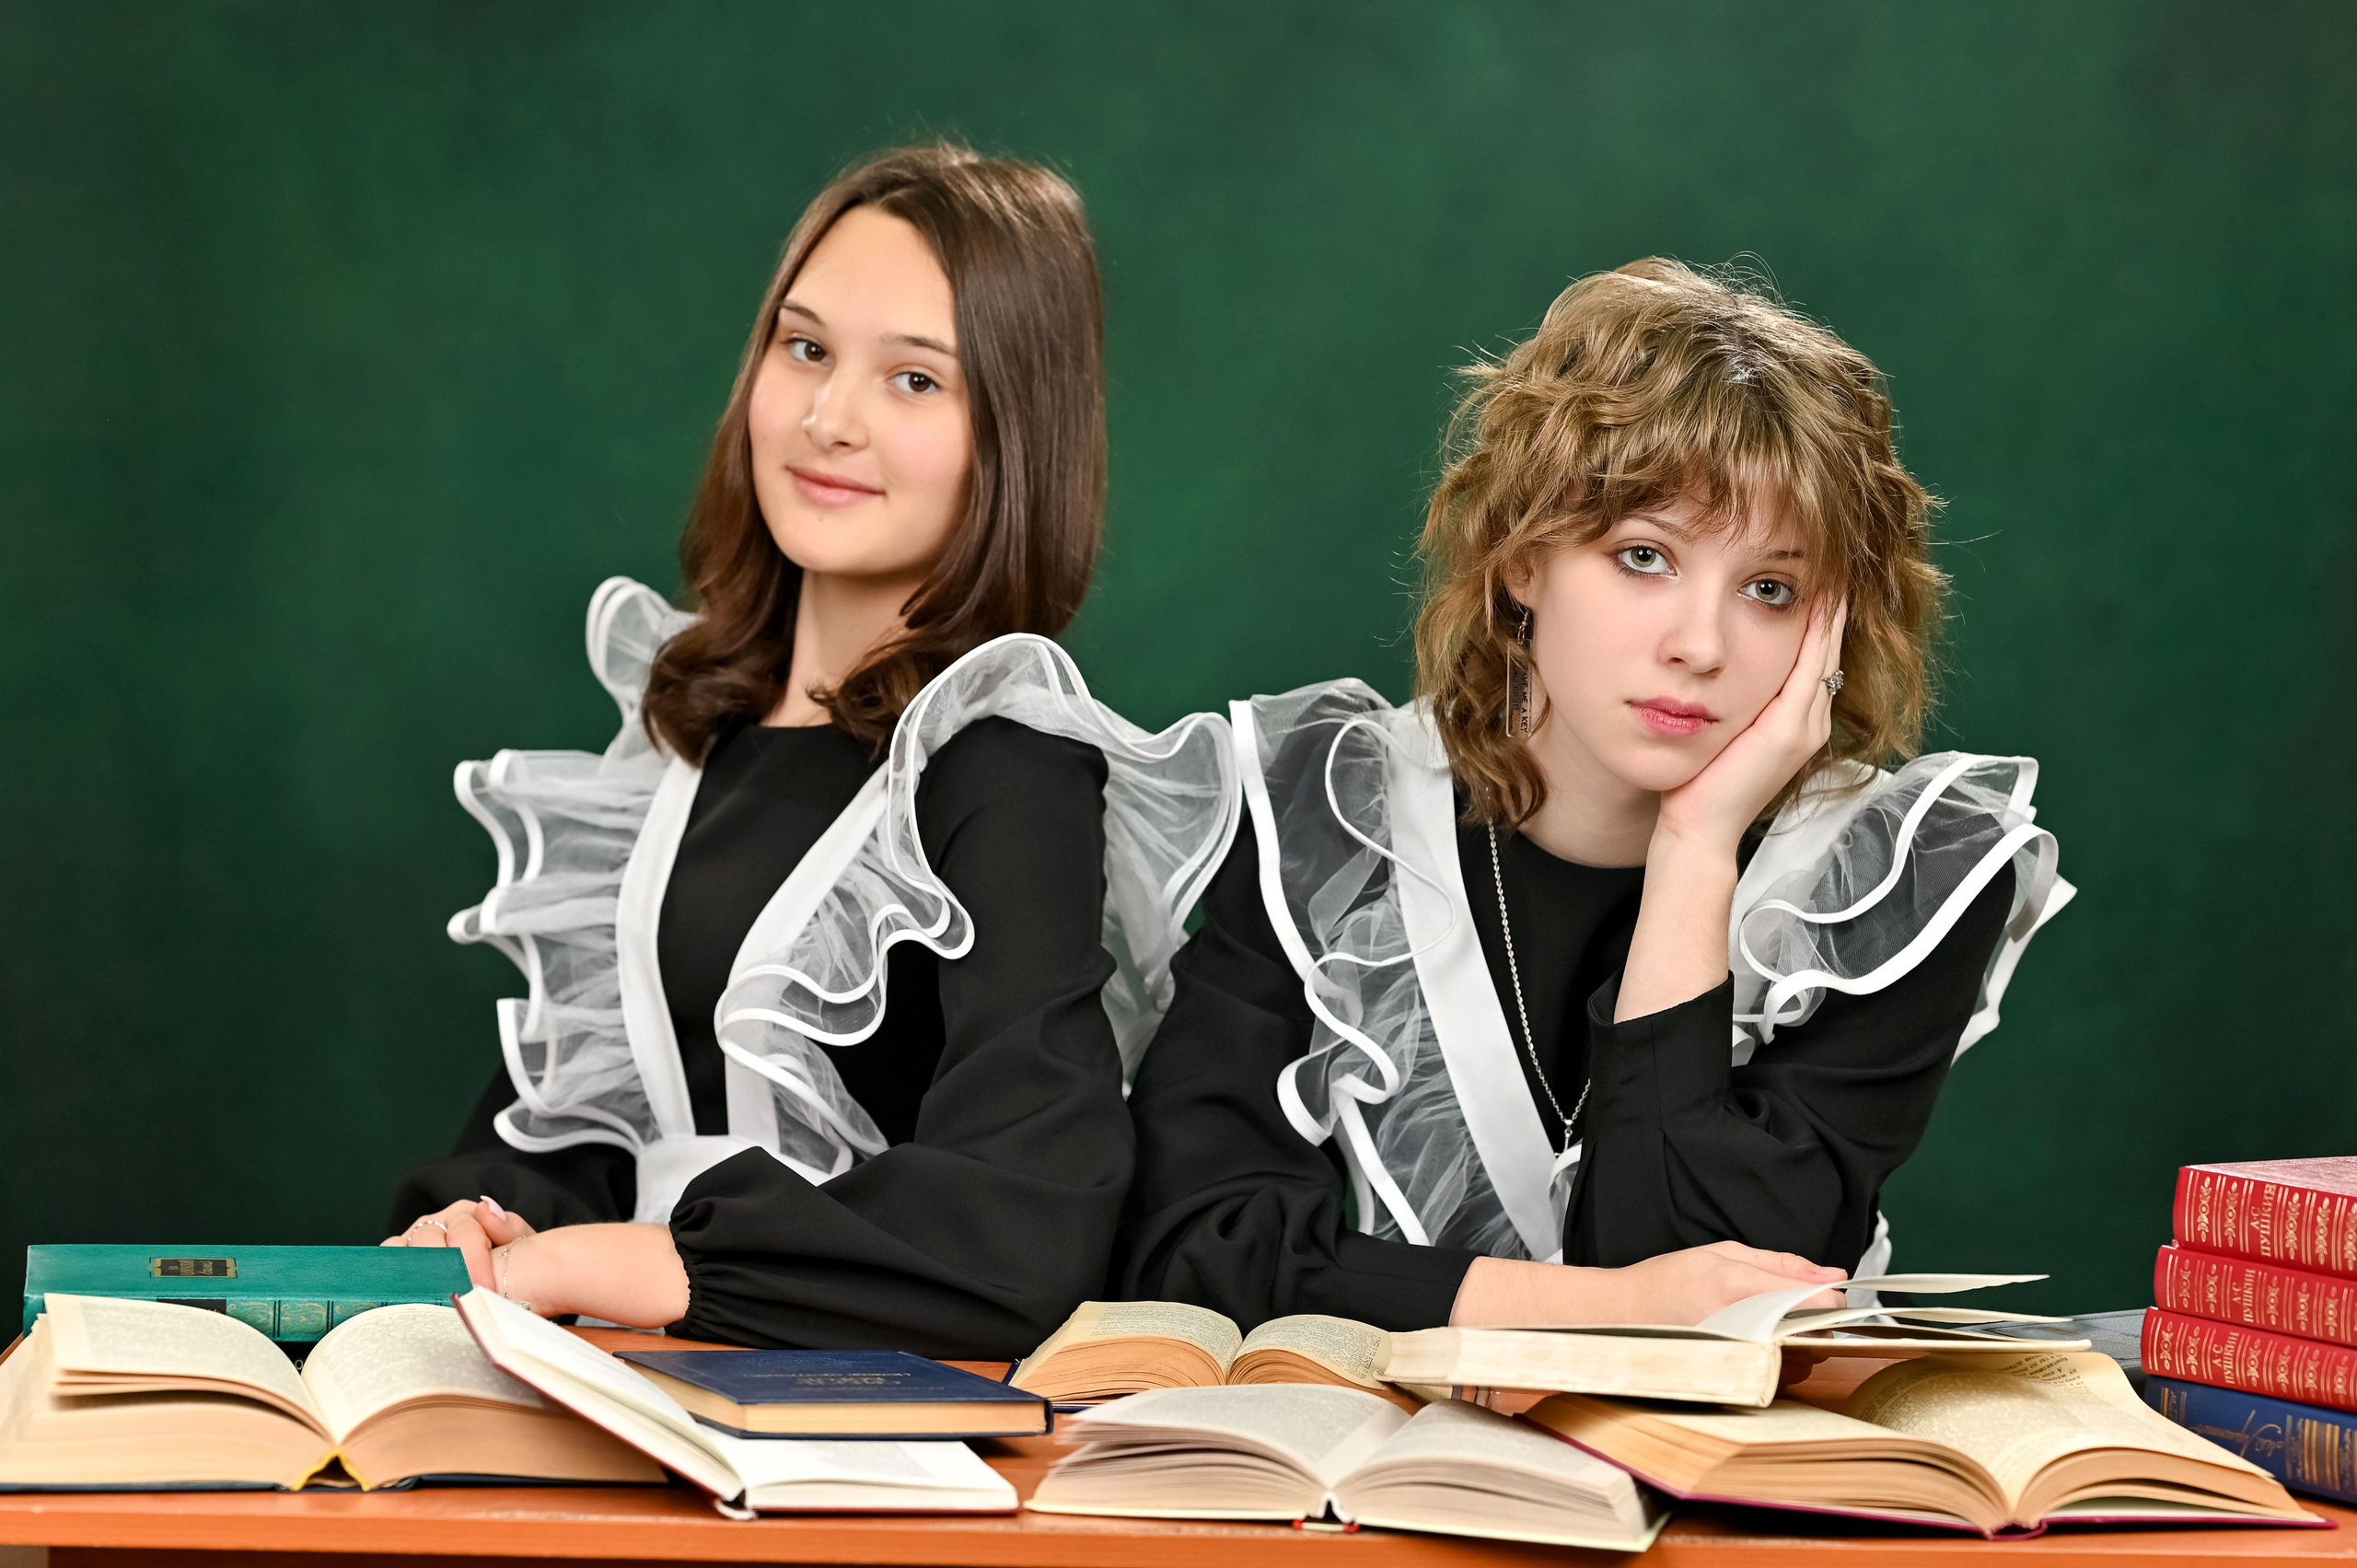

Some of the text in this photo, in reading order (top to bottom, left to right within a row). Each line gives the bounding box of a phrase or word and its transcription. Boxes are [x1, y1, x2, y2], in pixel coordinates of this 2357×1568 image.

[1522, 691, 1528, 703] ME
[1520, 716, 1528, 734] KEY
[2259, 1183, 2277, 1258] ПУШКИН
[2242, 1269, 2256, 1323] ПУШКИН
[2223, 1331, 2239, 1385] ПУШКИН
